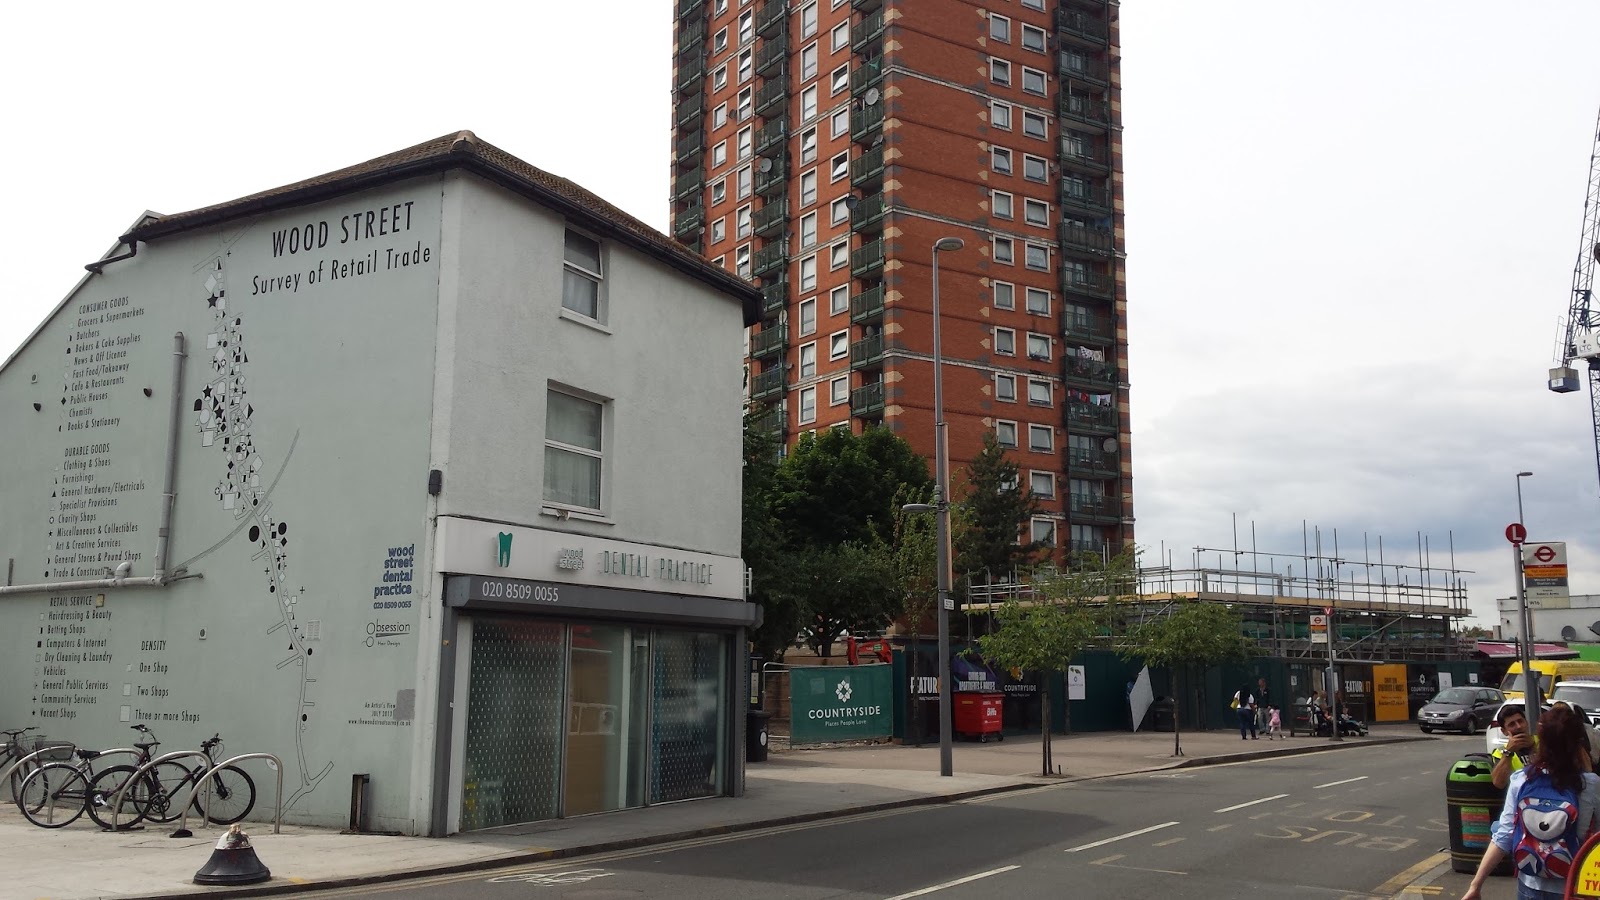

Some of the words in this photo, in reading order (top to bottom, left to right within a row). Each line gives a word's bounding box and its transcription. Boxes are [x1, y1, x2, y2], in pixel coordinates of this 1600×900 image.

[272, 221, 328, 258] WOOD
[340, 201, 414, 244] STREET
[252, 273, 300, 295] Survey
[309, 260, 323, 284] of
[331, 250, 376, 280] Retail
[386, 241, 430, 269] Trade
[79, 300, 108, 314] CONSUMER
[110, 297, 128, 309] GOODS
[78, 314, 98, 327] Grocers
[100, 314, 103, 323] &
[106, 308, 144, 322] Supermarkets
[77, 330, 99, 340] Butchers
[76, 341, 93, 352] Bakers
[96, 341, 99, 349] &
[102, 337, 114, 348] Cake
[117, 334, 140, 346] Supplies
[74, 356, 88, 365] News
[96, 352, 104, 362] Off
[106, 350, 126, 360] Licence
[73, 368, 84, 378] Fast
[85, 381, 89, 389] &
[91, 376, 124, 388] Restaurants
[70, 394, 86, 404] Public
[89, 392, 108, 402] Houses
[69, 407, 92, 417] Chemists
[68, 421, 83, 431] Books
[85, 420, 88, 428] &
[91, 418, 120, 428] Stationery
[65, 446, 89, 457] DURABLE
[91, 443, 110, 454] GOODS
[64, 460, 86, 470] Clothing
[95, 458, 111, 467] Shoes
[62, 473, 94, 483] Furnishings
[61, 487, 82, 497] General
[84, 480, 144, 495] Hardware/Electricals
[60, 500, 86, 510] Specialist
[88, 498, 117, 507] Provisions
[58, 514, 78, 524] Charity
[80, 512, 96, 522] Shops
[57, 527, 95, 537] Miscellaneous
[104, 523, 138, 533] Collectibles
[1513, 526, 1522, 540] L
[72, 539, 95, 549] Creative
[97, 538, 121, 548] Services
[55, 553, 76, 564] General
[78, 553, 95, 562] Stores
[98, 553, 101, 561] &
[104, 551, 122, 561] Pound
[124, 549, 141, 561] Shops
[388, 544, 414, 557] wood
[384, 557, 413, 569] street
[604, 551, 649, 577] DENTAL
[660, 558, 712, 584] PRACTICE
[54, 568, 68, 578] Trade
[71, 567, 74, 576] &
[77, 565, 112, 576] Constructi
[383, 569, 413, 582] dental
[374, 583, 412, 599] practice
[482, 581, 502, 597] 020
[506, 584, 531, 599] 8509
[535, 586, 558, 601] 0055
[51, 597, 68, 607] RETAIL
[70, 596, 92, 606] SERVICE
[49, 611, 83, 621] Hairdressing
[86, 611, 89, 619] &
[92, 609, 112, 620] Beauty
[48, 625, 67, 635] Betting
[69, 624, 85, 634] Shops
[367, 619, 410, 635] Obsession
[47, 639, 75, 649] Computers
[77, 639, 80, 647] &
[83, 638, 106, 647] Internet
[141, 640, 166, 650] DENSITY
[45, 653, 54, 663] Dry
[57, 652, 81, 663] Cleaning
[83, 653, 87, 661] &
[89, 651, 112, 663] Laundry
[43, 667, 66, 675] Vehicles
[139, 663, 151, 672] One
[153, 662, 168, 674] Shop
[43, 680, 64, 689] General
[66, 680, 83, 689] Public
[86, 680, 108, 689] Services
[138, 686, 148, 696] Two
[151, 686, 168, 698] Shops
[41, 695, 71, 705] Community
[73, 695, 97, 703] Services
[40, 708, 58, 718] Vacant
[60, 708, 76, 718] Shops
[136, 710, 151, 720] Three
[163, 712, 179, 721] more
[182, 711, 199, 723] Shops
[809, 706, 880, 719] COUNTRYSIDE
[1585, 880, 1600, 891] TY
